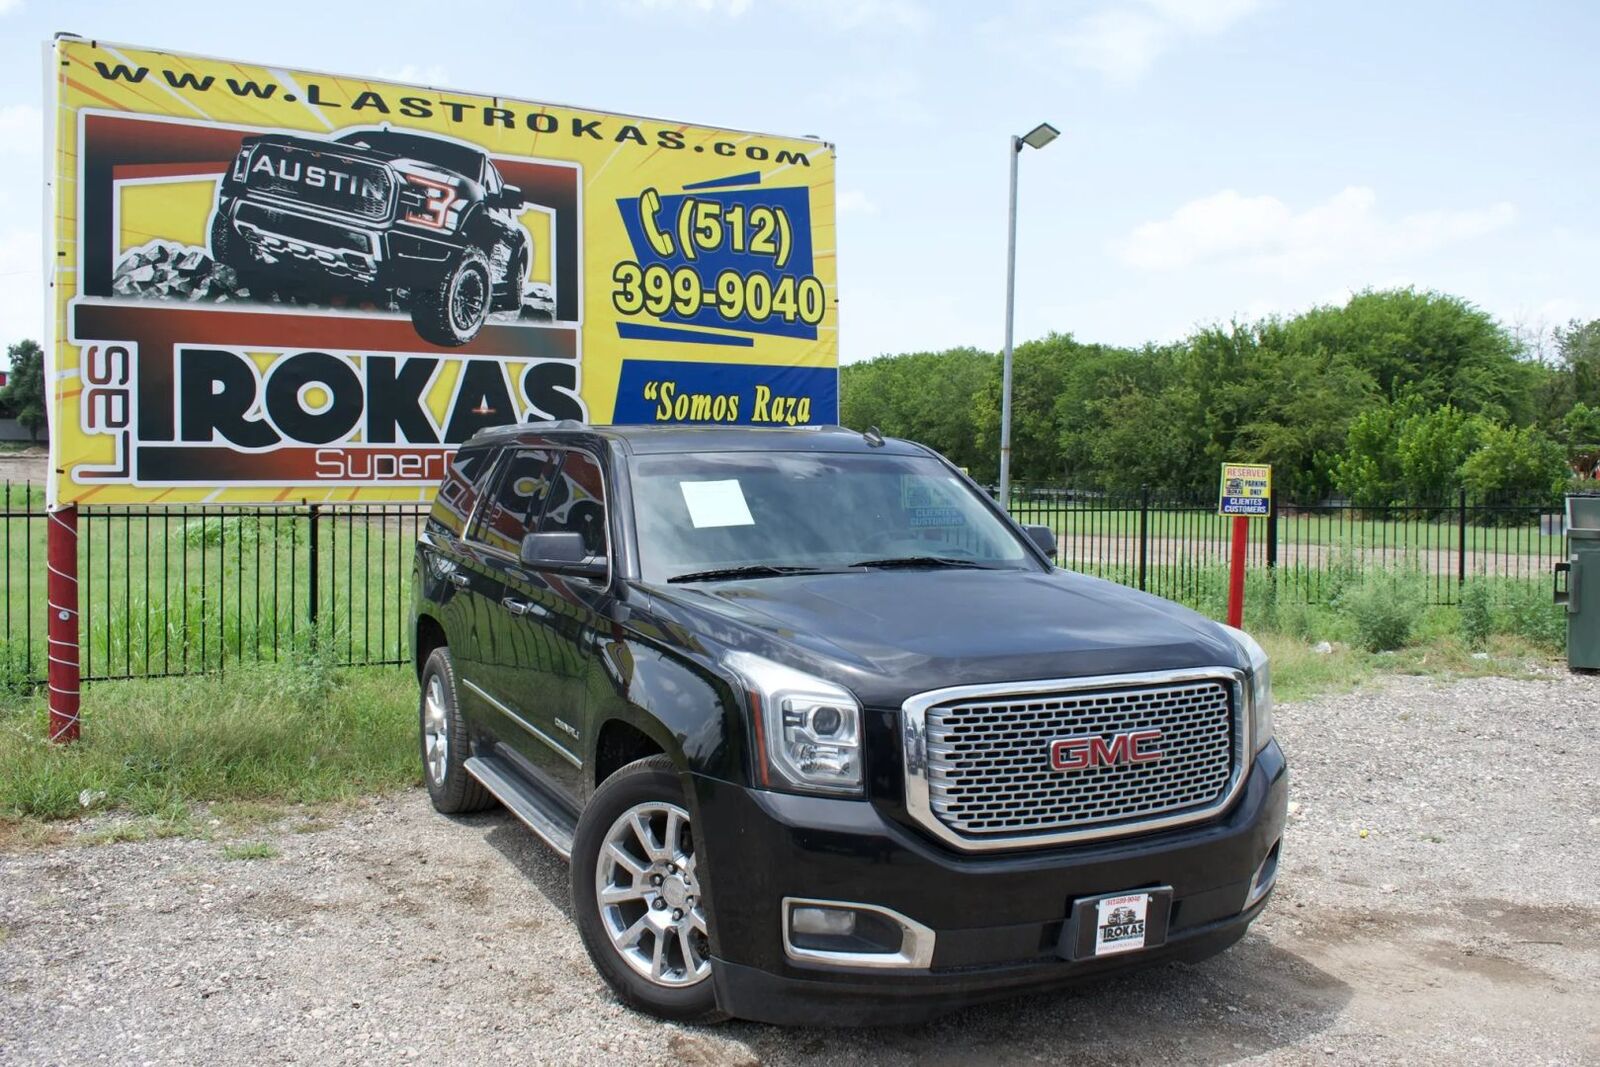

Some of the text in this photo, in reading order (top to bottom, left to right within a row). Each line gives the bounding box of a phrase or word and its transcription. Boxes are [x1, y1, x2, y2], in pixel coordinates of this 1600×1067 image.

[252, 154, 384, 200] AUSTIN
[679, 198, 792, 267] (512)
[613, 262, 824, 325] 399-9040
[78, 345, 130, 478] Las
[752, 385, 811, 425] Raza
[1227, 468, 1267, 477] RESERVED
[1224, 505, 1266, 513] CUSTOMERS
[1051, 729, 1163, 770] GMC
[1100, 922, 1144, 939] TROKAS
